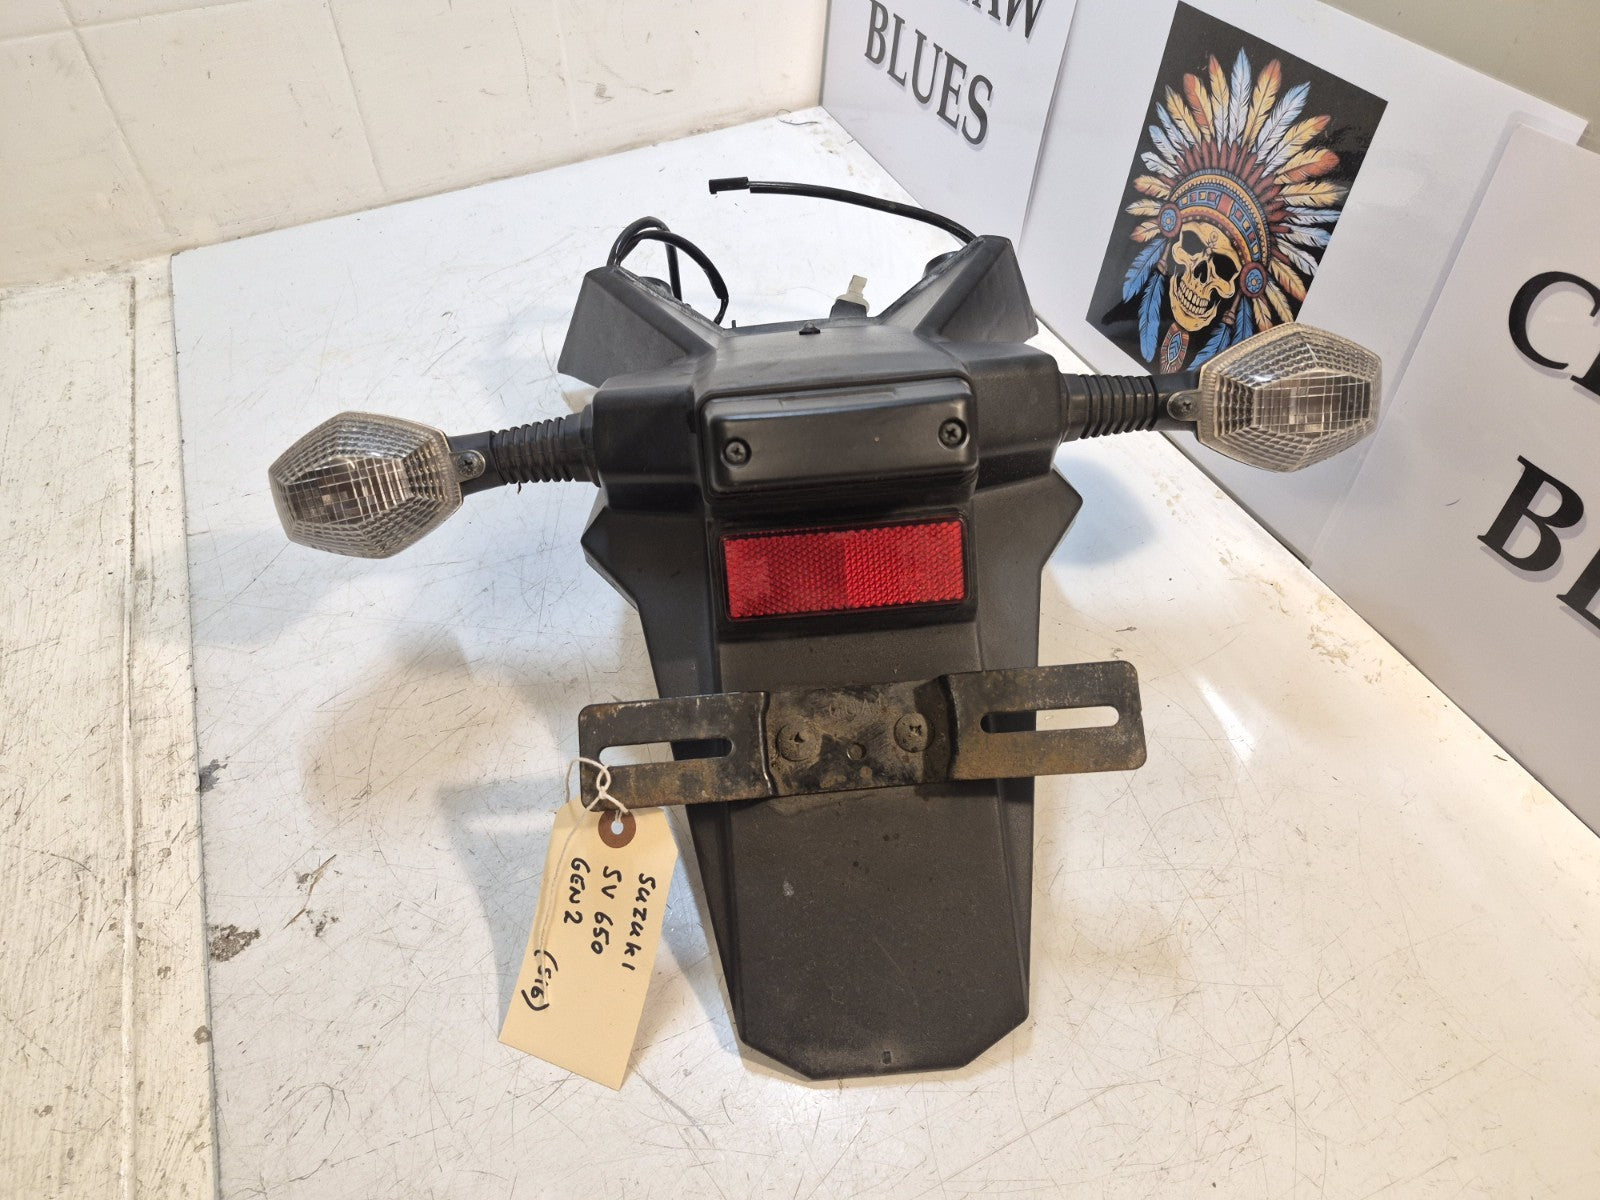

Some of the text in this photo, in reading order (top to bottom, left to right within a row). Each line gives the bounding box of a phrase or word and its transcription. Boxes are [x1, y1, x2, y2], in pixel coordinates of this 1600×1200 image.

[864, 0, 993, 145] BLUES
[1508, 270, 1600, 397] C
[563, 857, 590, 924] GEN 2
[590, 866, 622, 955] SV 650
